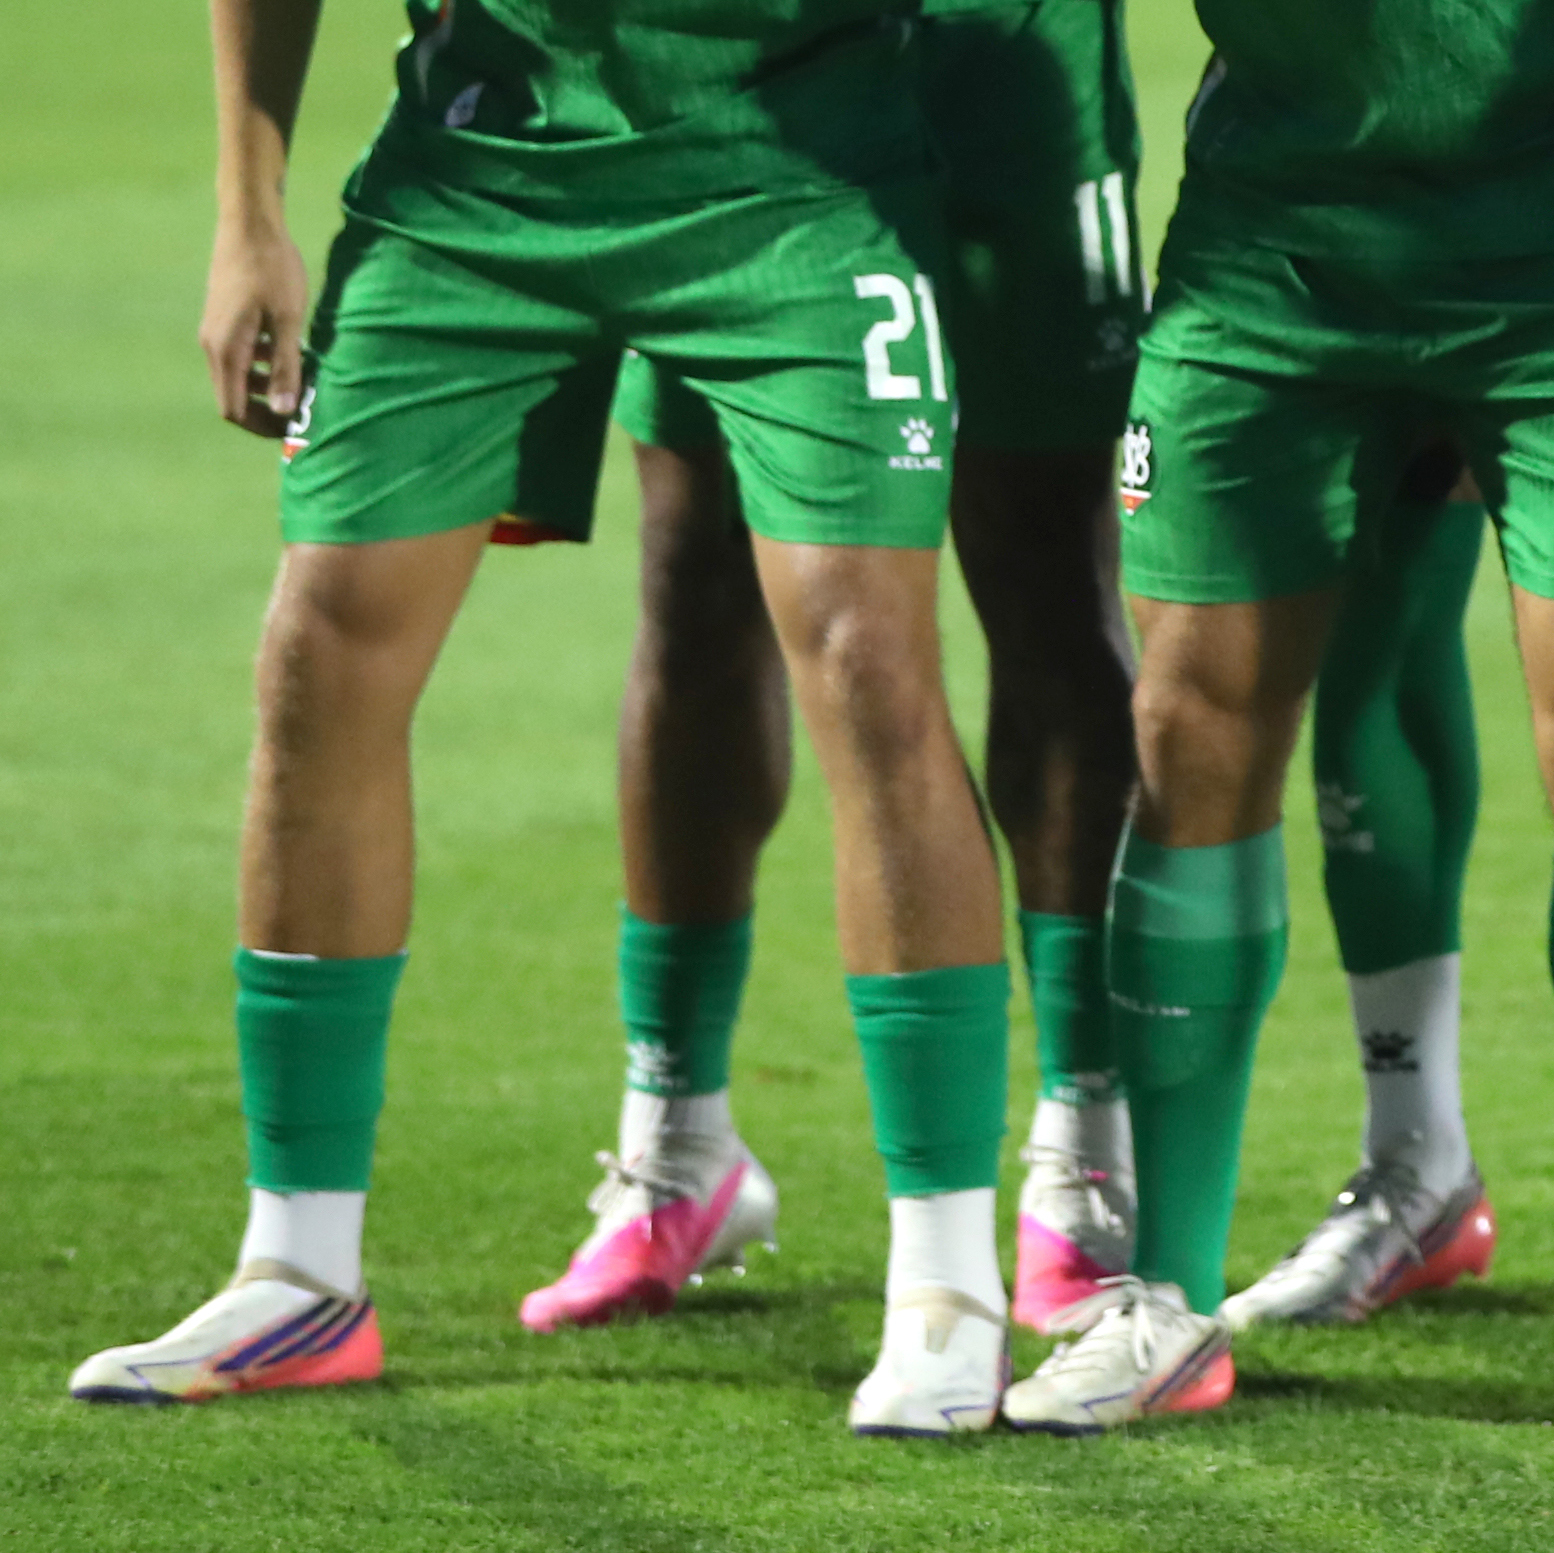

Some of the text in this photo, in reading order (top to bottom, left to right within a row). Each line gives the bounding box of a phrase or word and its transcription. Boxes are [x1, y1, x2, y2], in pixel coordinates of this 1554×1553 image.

[1075, 171, 1132, 305] 11
[854, 273, 948, 402] 21
[888, 455, 943, 471] KELME
